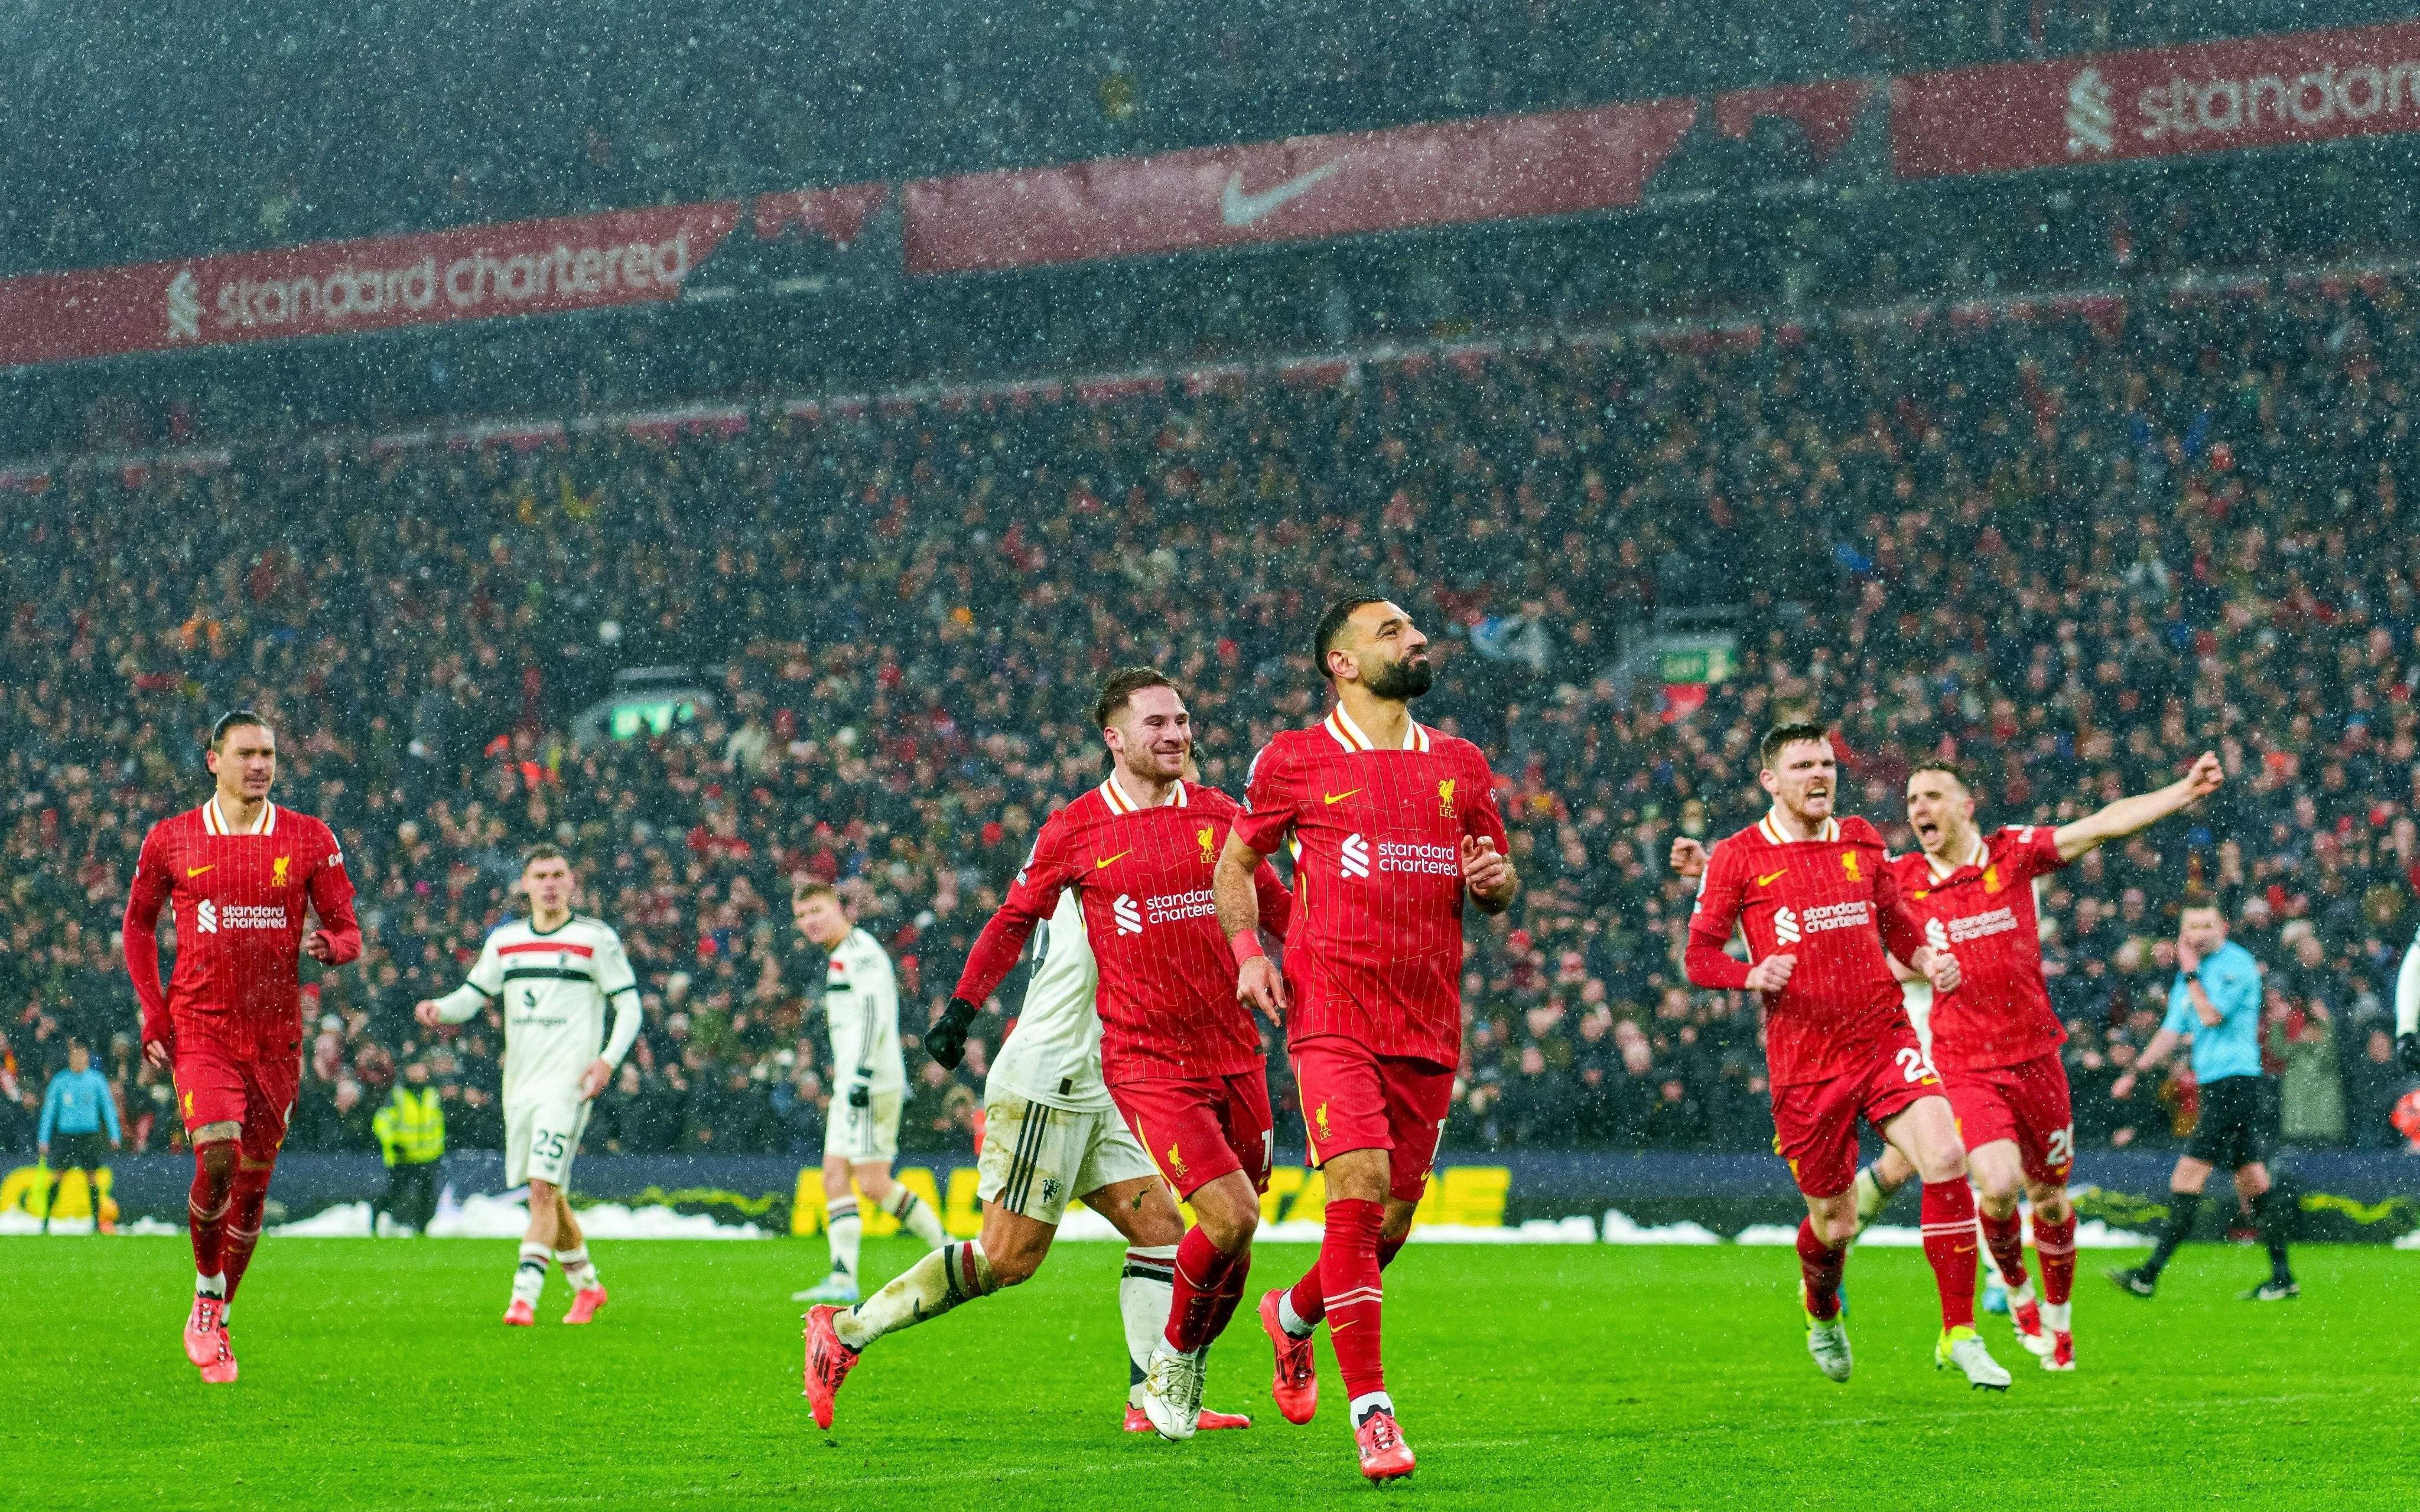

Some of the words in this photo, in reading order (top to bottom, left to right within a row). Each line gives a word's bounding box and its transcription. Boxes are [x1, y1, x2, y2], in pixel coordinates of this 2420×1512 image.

[2139, 63, 2420, 139] standar
[217, 255, 435, 328] standard
[446, 232, 687, 305] chartered
[1378, 841, 1455, 861] standard
[1379, 858, 1458, 876] chartered
[222, 904, 285, 917] standard
[222, 915, 287, 929] chartered
[1149, 902, 1216, 924] chartere
[532, 1128, 564, 1159] 25
[1261, 1126, 1274, 1172] 1
[1429, 1116, 1448, 1166] 1
